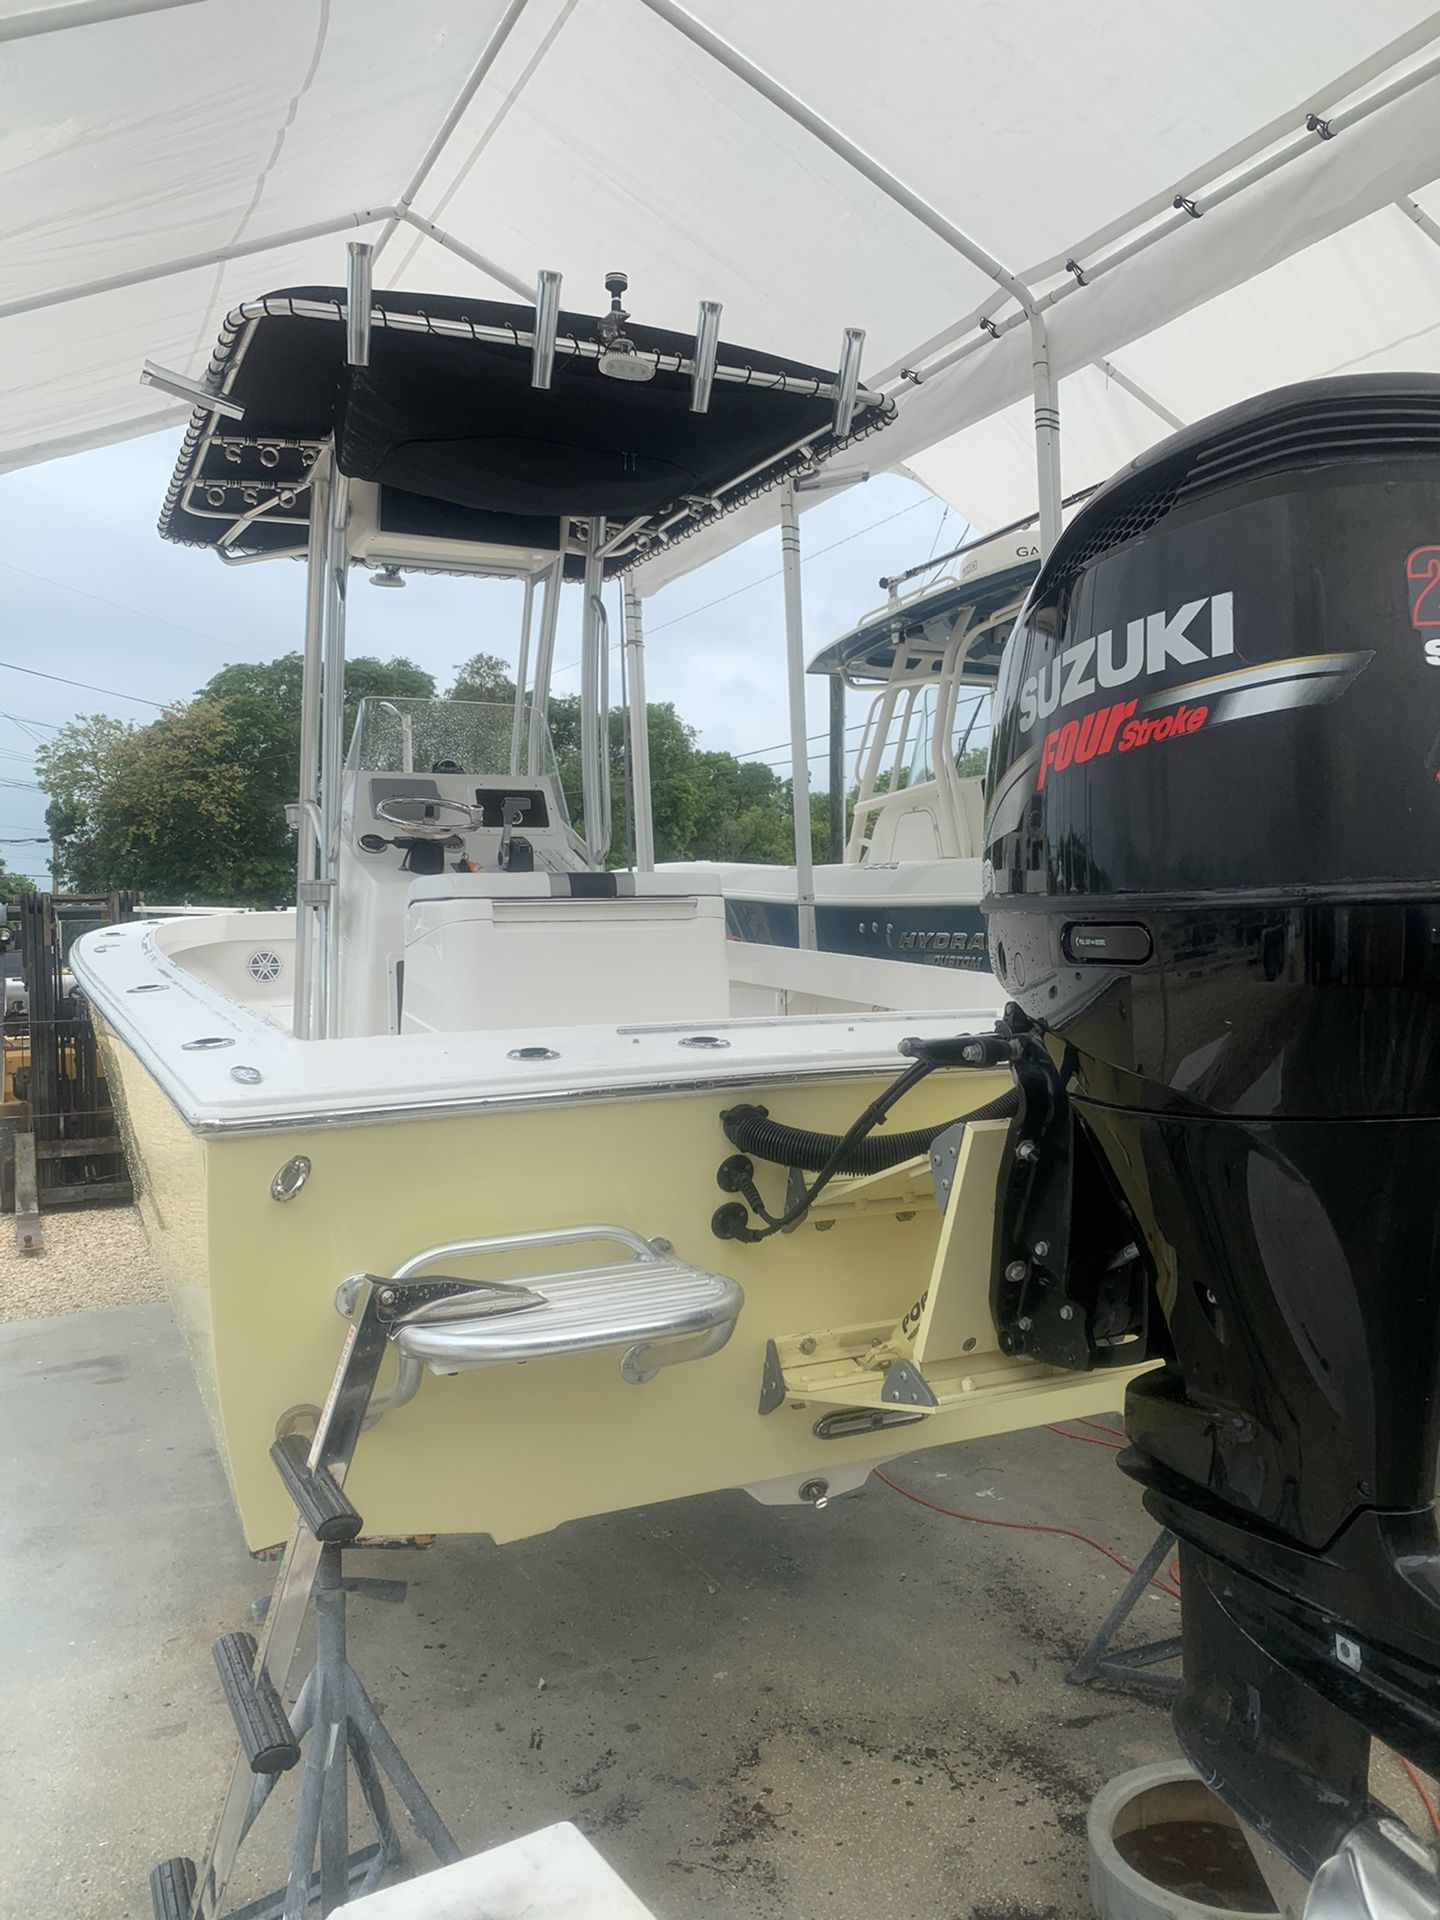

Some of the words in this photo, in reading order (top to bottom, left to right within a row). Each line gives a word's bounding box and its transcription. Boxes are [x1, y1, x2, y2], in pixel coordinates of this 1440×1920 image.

[1019, 590, 1234, 733] SUZUKI
[1118, 705, 1208, 752] Stroke
[899, 932, 985, 949] HYDRA
